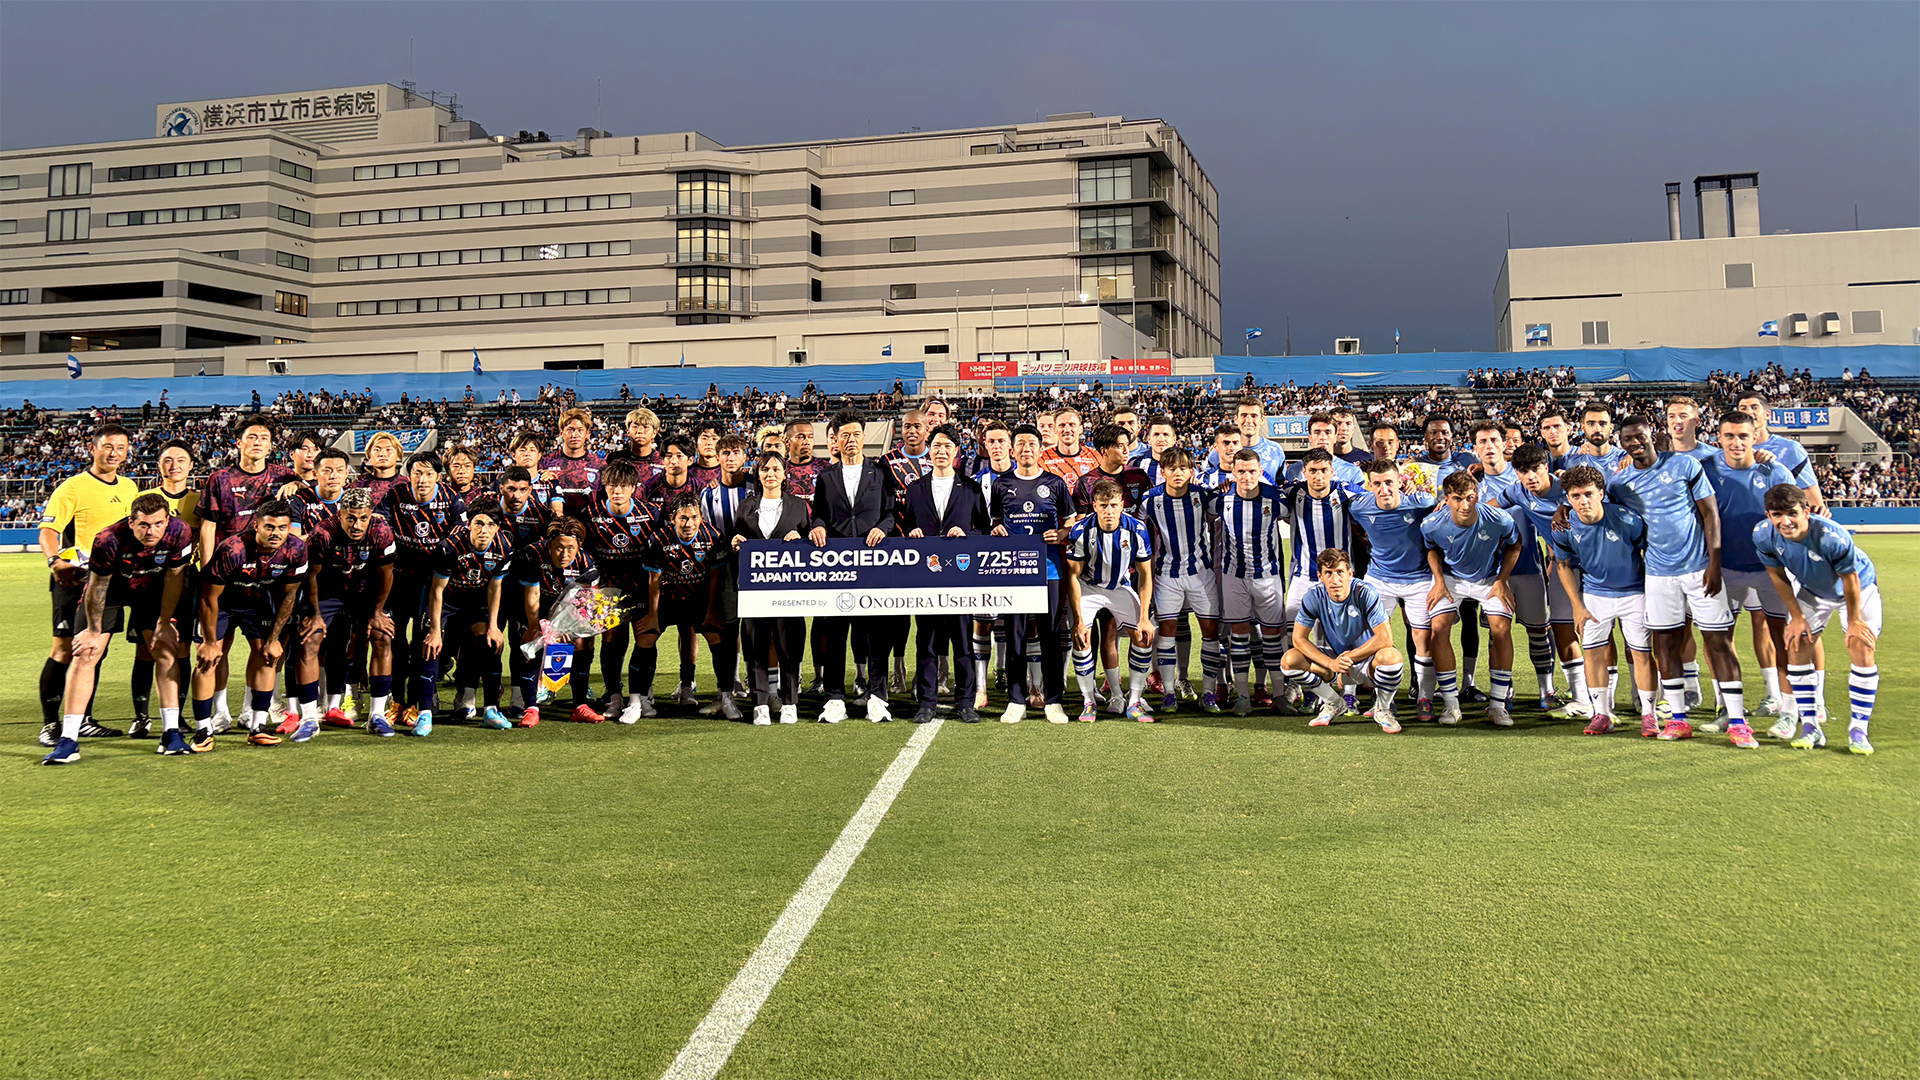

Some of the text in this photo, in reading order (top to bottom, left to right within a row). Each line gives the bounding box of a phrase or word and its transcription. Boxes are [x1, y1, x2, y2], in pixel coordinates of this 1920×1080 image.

[203, 91, 377, 128] 横浜市立市民病院
[1769, 411, 1828, 425] 山田康太
[1274, 422, 1310, 435] 福森
[750, 549, 920, 568] REAL SOCIEDAD
[977, 551, 1012, 567] 7.25
[750, 571, 857, 583] JAPAN TOUR 2025
[859, 593, 1013, 609] ONODERA USER RUN
